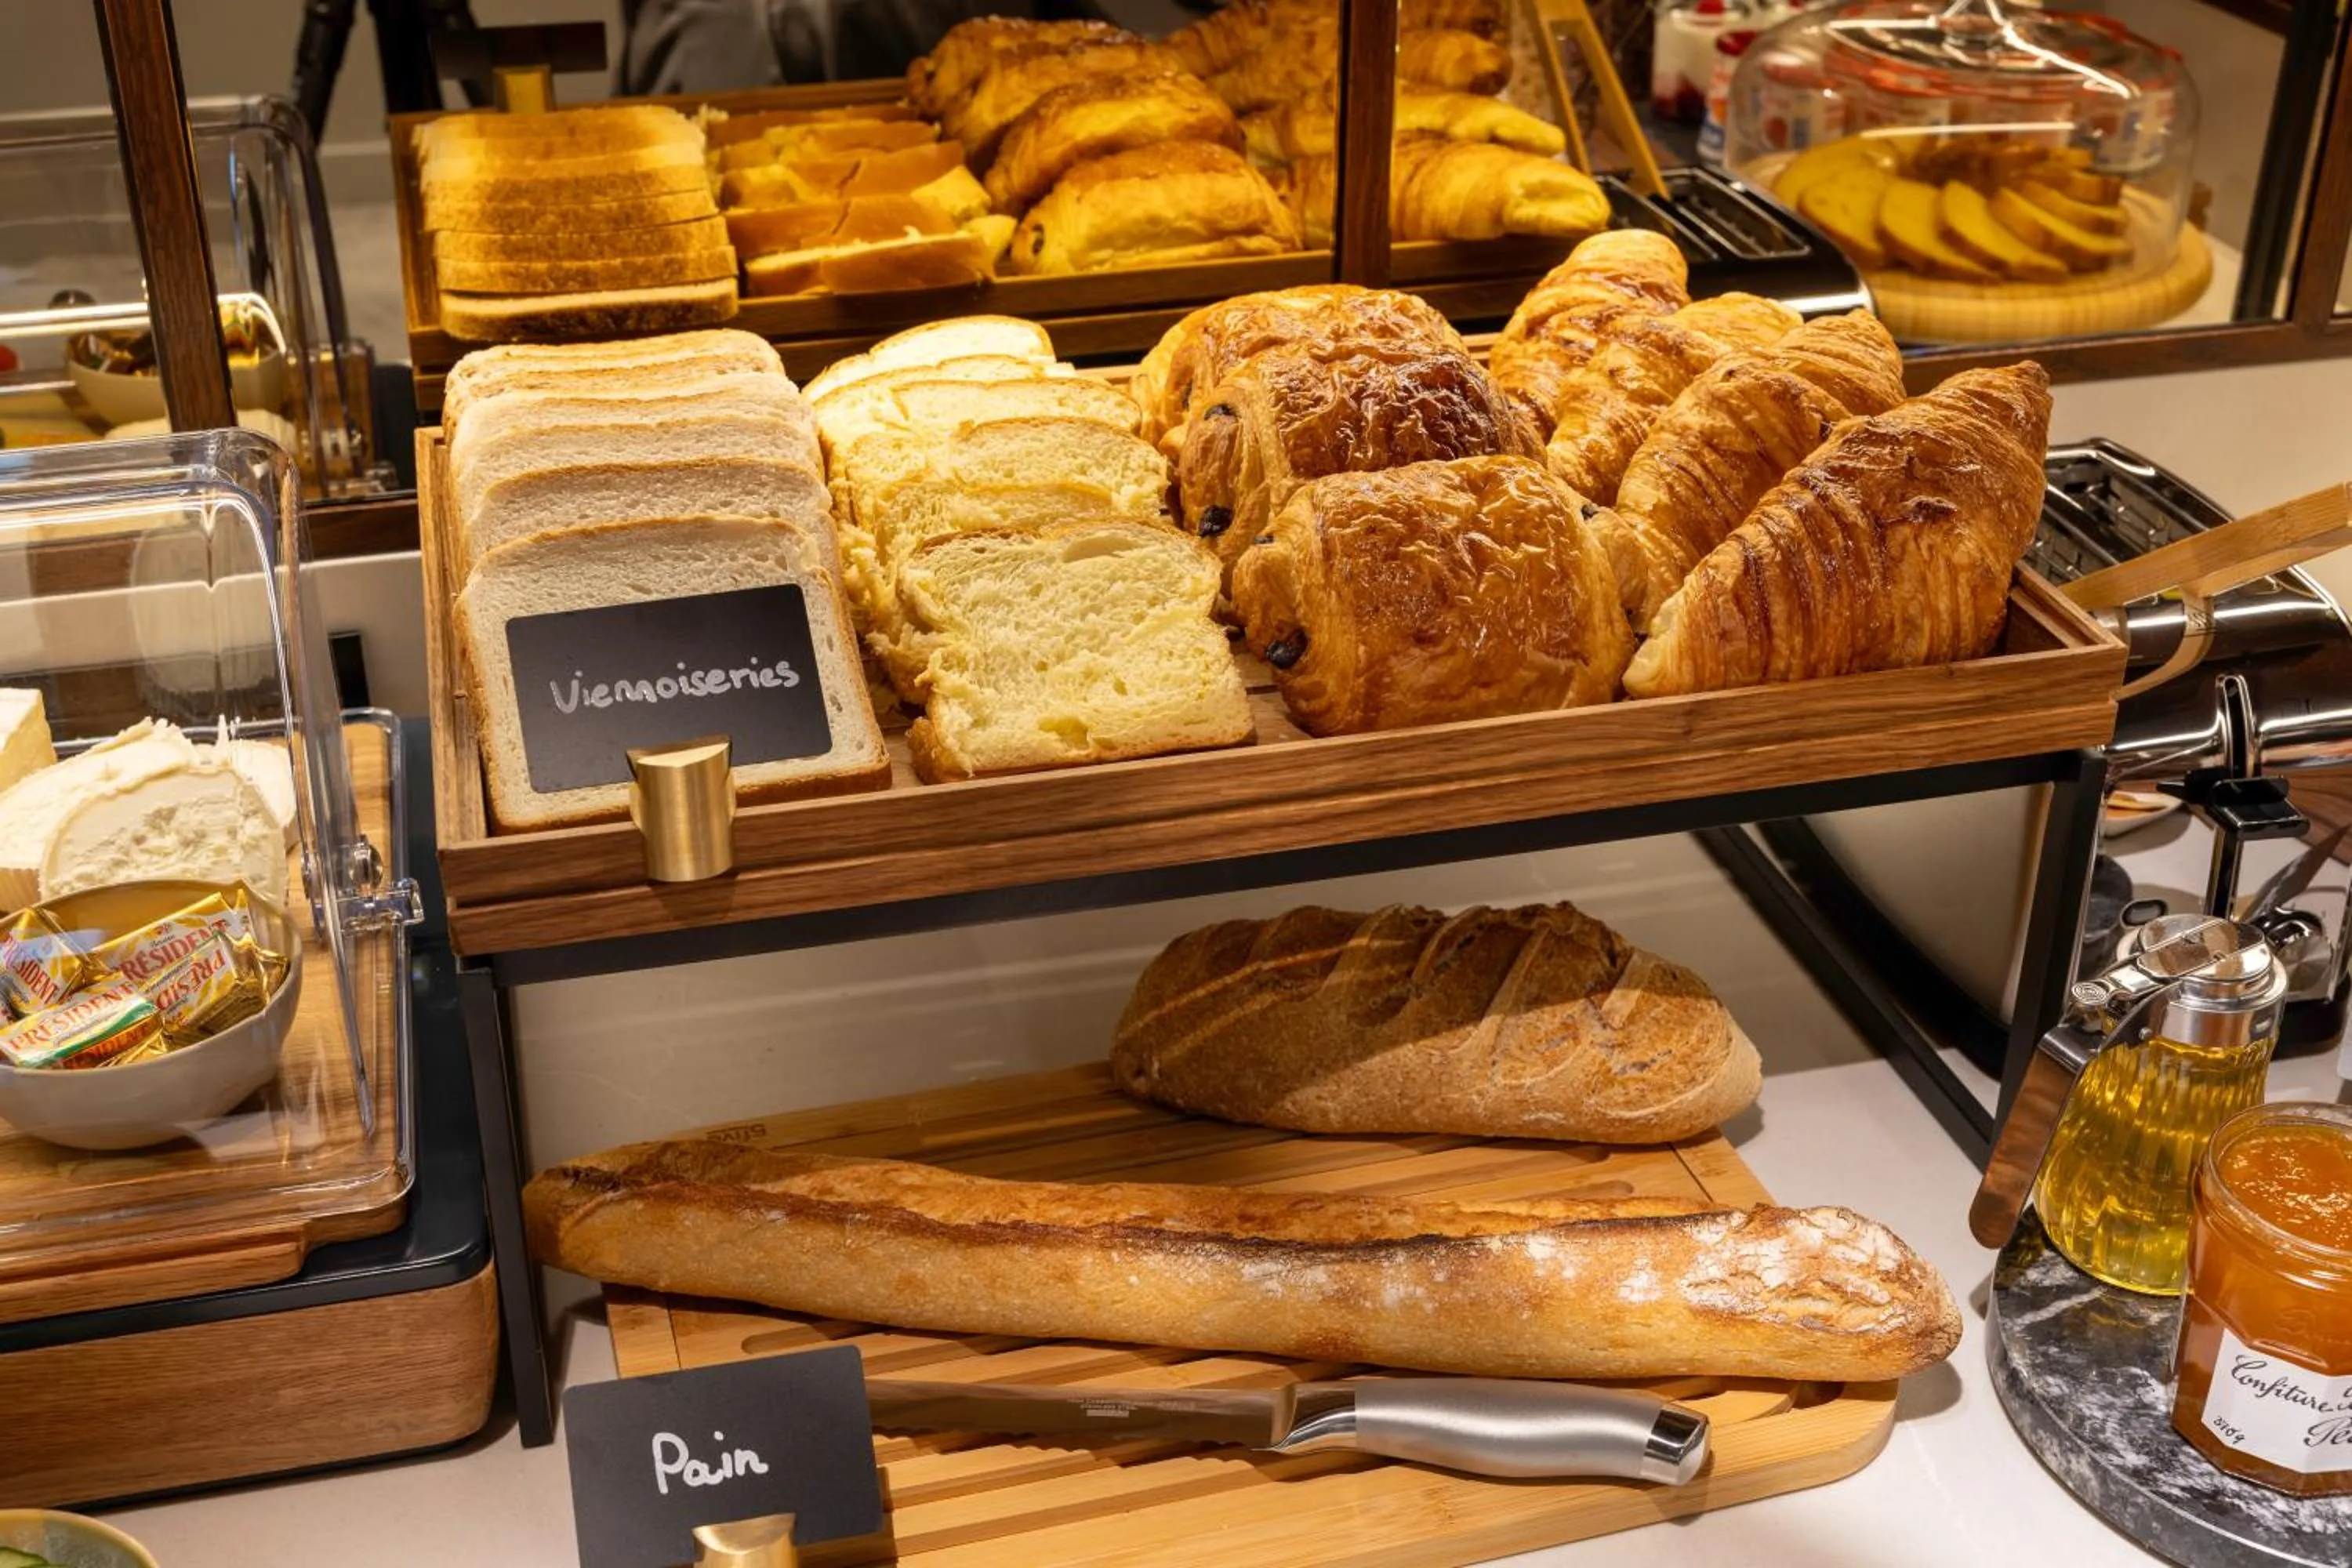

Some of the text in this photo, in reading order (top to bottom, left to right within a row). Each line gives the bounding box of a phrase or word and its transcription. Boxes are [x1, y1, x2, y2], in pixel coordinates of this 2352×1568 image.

[550, 656, 800, 714] Viennoiseries
[2230, 1354, 2334, 1412] Confiture
[652, 1430, 769, 1495] Pain
